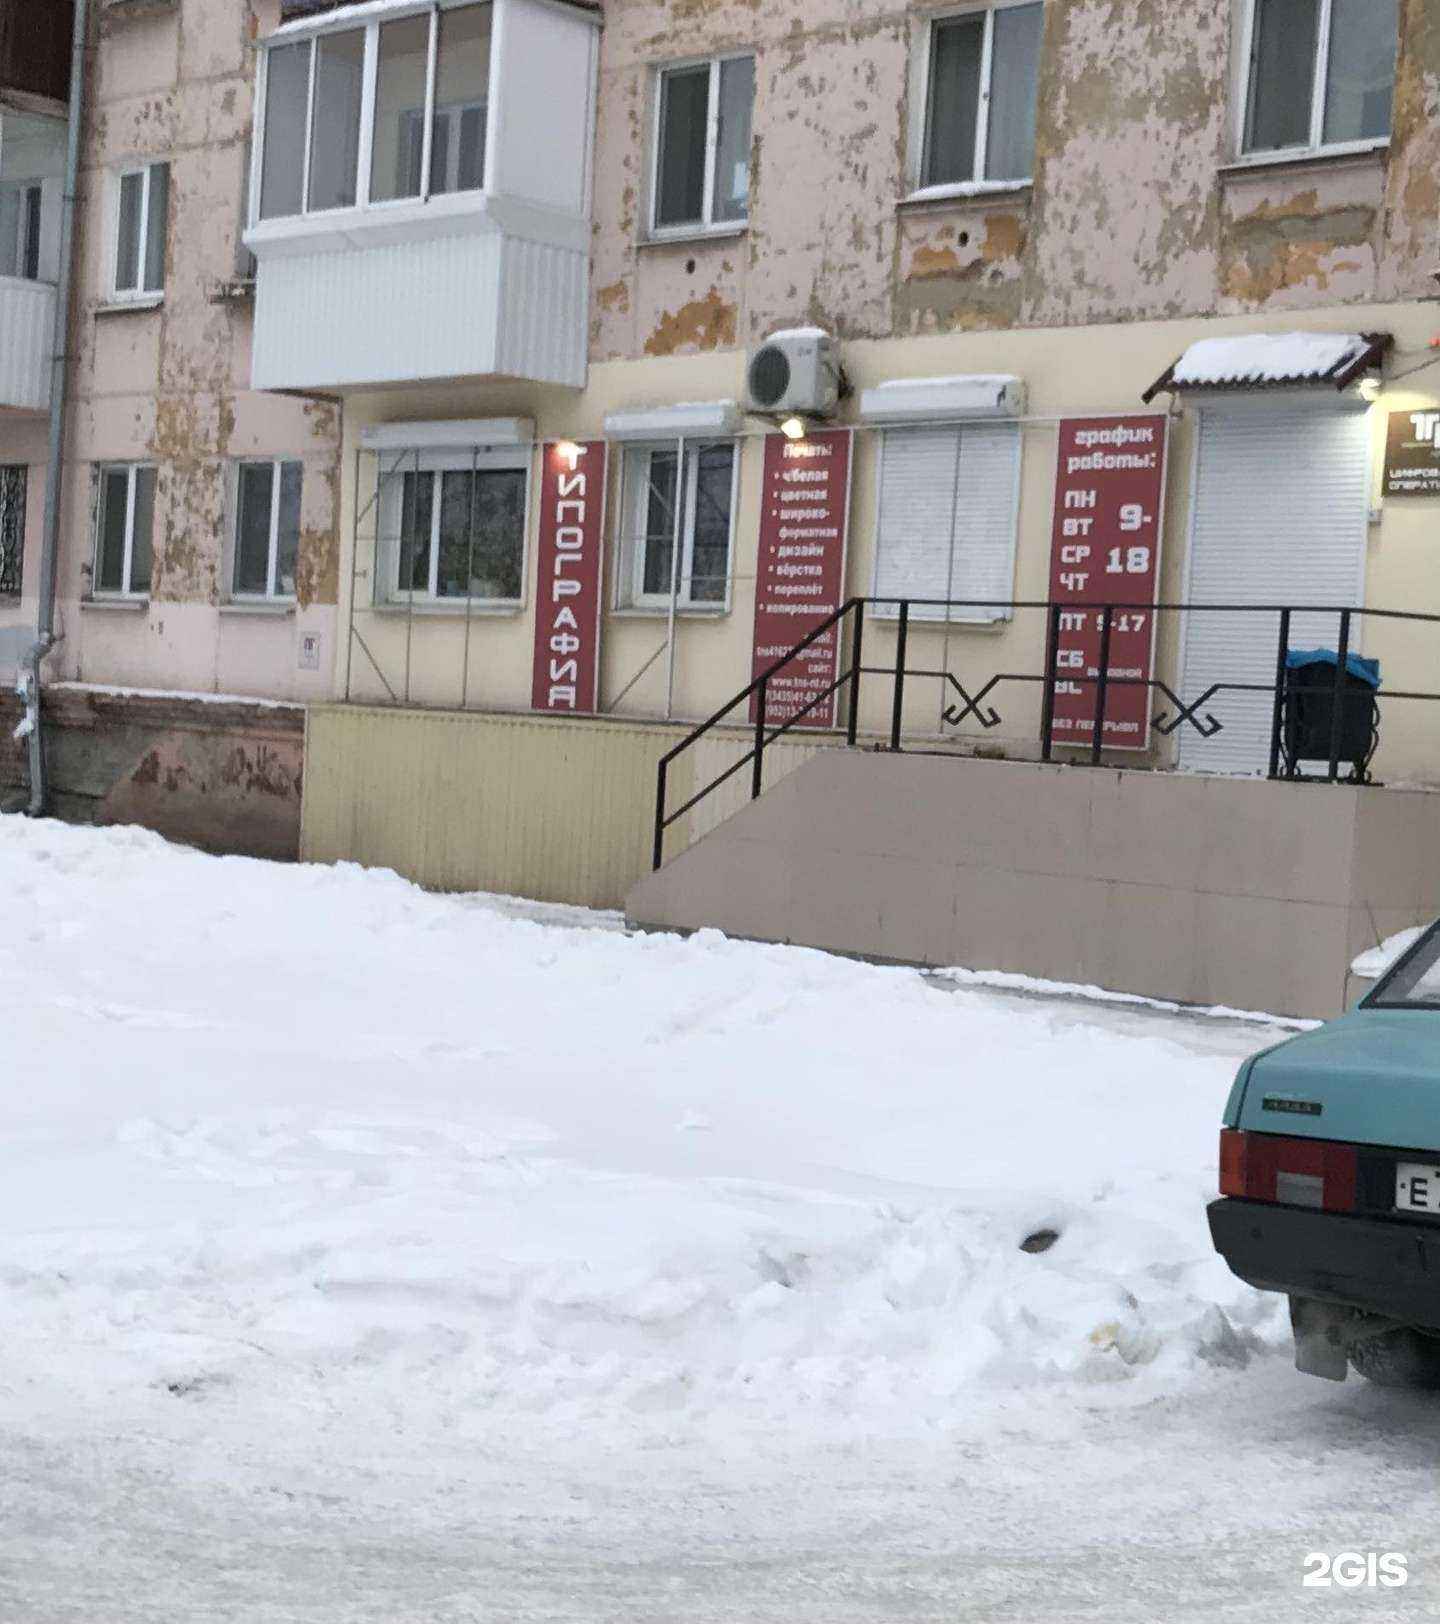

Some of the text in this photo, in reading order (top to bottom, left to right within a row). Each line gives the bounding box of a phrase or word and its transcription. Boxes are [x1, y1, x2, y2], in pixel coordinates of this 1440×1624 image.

[1075, 425, 1153, 447] график
[1067, 452, 1156, 474] работы:
[1064, 490, 1097, 508] ПН
[1062, 518, 1093, 536] ВТ
[1061, 545, 1091, 563] СР
[1106, 547, 1150, 573] 18
[549, 444, 587, 708] ТИПОГРАФИЯ
[1059, 572, 1089, 591] ЧТ
[1058, 613, 1087, 631] ПТ
[1056, 650, 1084, 668] СБ
